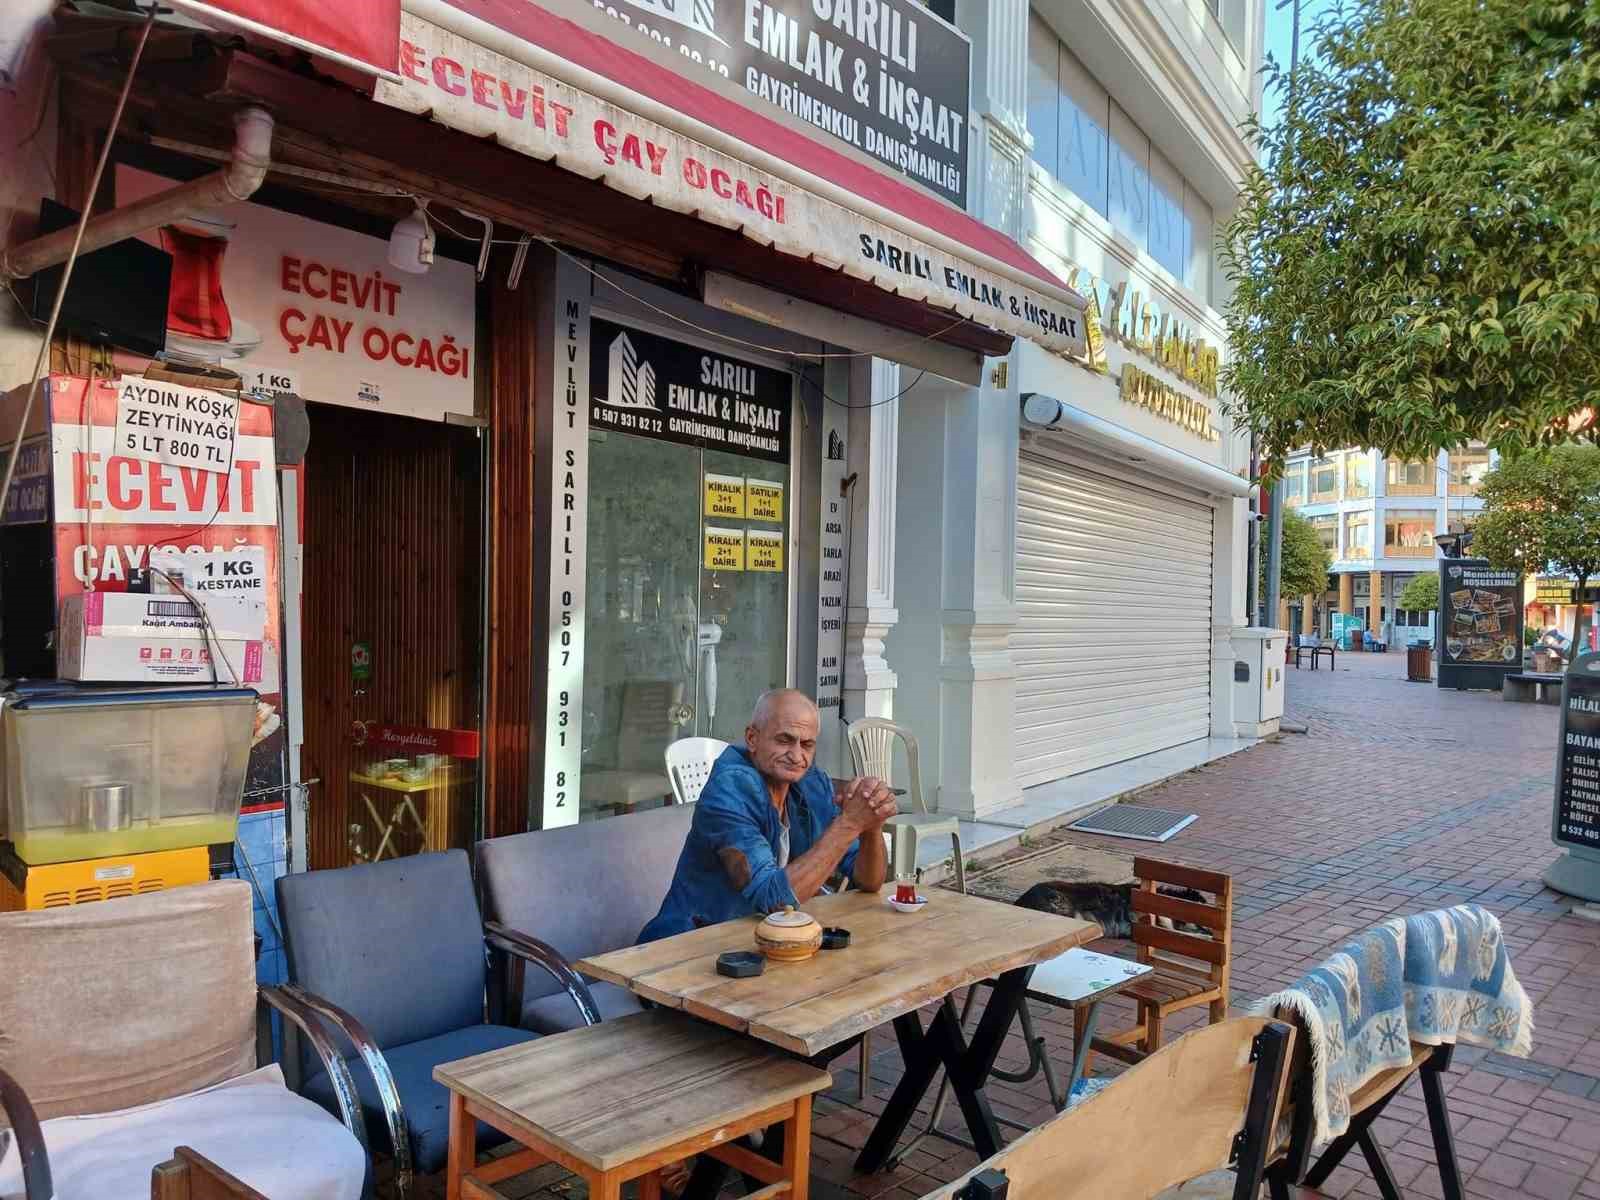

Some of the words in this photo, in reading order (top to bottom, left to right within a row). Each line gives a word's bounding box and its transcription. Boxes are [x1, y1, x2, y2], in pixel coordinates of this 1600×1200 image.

[744, 0, 844, 93] EMLAK
[853, 58, 870, 107] &
[879, 59, 963, 153] İNŞAAT
[400, 39, 573, 138] ECEVİT
[593, 119, 667, 176] ÇAY
[683, 157, 785, 225] OCAĞI
[746, 66, 861, 146] GAYRİMENKUL
[865, 126, 960, 193] DANIŞMANLIĞI
[282, 256, 402, 316] ECEVİT
[859, 233, 933, 281] SARILI
[944, 267, 1005, 310] EMLAK
[1009, 296, 1021, 316] &
[1024, 296, 1077, 338] İNŞAAT
[280, 308, 353, 353] ÇAY
[363, 327, 470, 378] OCAĞI
[565, 300, 579, 428] MEVLÜT
[700, 356, 756, 397] SARILI
[257, 373, 265, 385] 1
[270, 375, 291, 389] KG
[122, 385, 179, 408] AYDIN
[186, 395, 234, 420] KÖŞK
[668, 384, 717, 418] EMLAK
[721, 397, 731, 420] &
[735, 394, 782, 433] İNŞAAT
[126, 409, 234, 440] ZEYTİNYAĞI
[593, 407, 600, 420] 0
[602, 409, 618, 424] 507
[621, 414, 636, 428] 931
[639, 417, 649, 431] 82
[652, 419, 663, 433] 12
[127, 434, 136, 449] 5
[143, 436, 164, 453] LT
[170, 440, 199, 458] 800
[206, 446, 225, 463] TL
[669, 418, 726, 442] GAYRİMENKUL
[727, 430, 780, 453] DANIŞMANLIĞI
[708, 481, 742, 494] KİRALIK
[750, 487, 780, 498] SATILIK
[713, 504, 737, 514] DAİRE
[753, 508, 776, 517] DAİRE
[830, 502, 838, 513] EV
[708, 536, 742, 546] KİRALIK
[750, 538, 780, 548] KİRALIK
[825, 522, 842, 534] ARSA
[74, 544, 144, 592] ÇAY
[713, 557, 737, 566] DAİRE
[754, 560, 776, 568] DAİRE
[823, 547, 842, 559] TARLA
[204, 561, 214, 576] 1
[223, 561, 254, 576] KG
[196, 578, 261, 590] KESTANE
[561, 591, 571, 666] 0507
[558, 691, 569, 747] 931
[555, 771, 566, 808] 82
